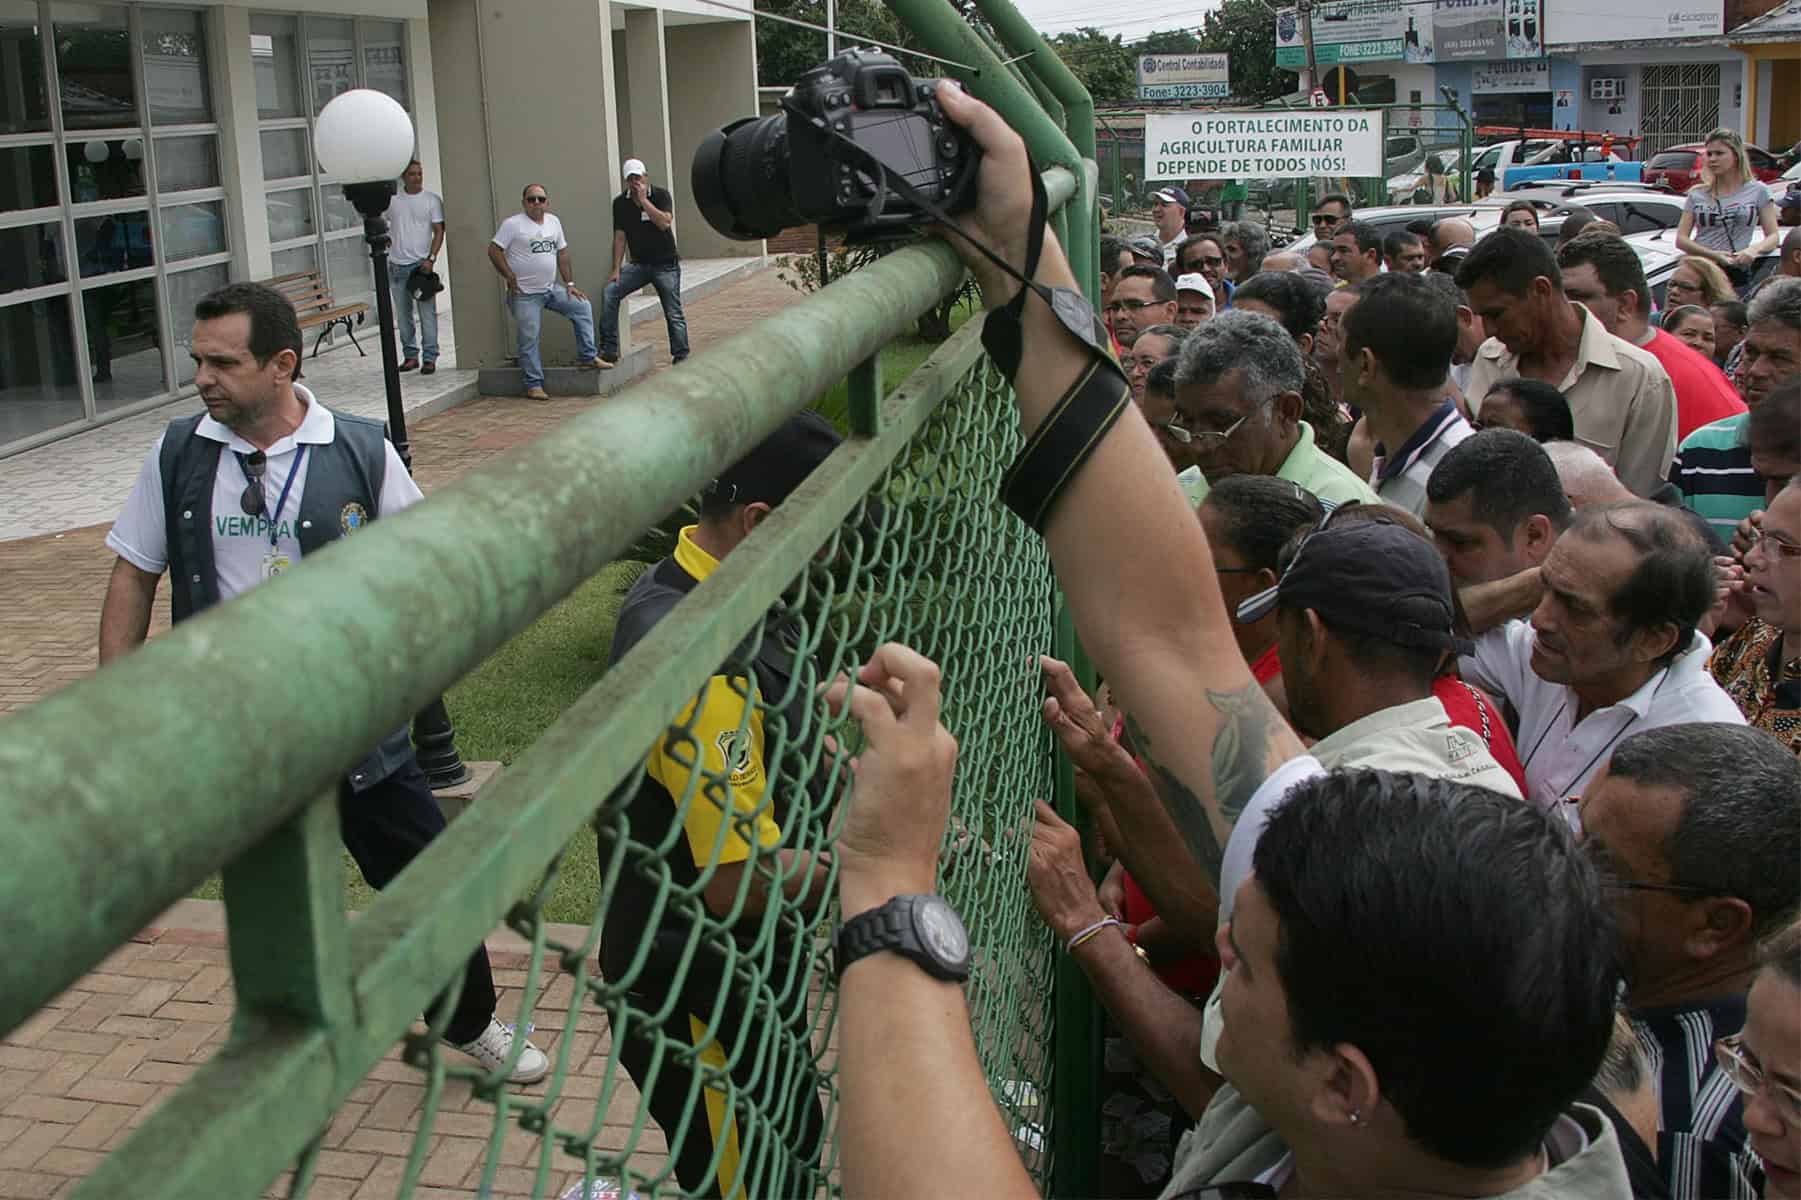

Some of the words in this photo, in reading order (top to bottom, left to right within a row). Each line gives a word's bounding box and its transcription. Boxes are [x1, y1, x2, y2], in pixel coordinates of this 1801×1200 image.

[1157, 59, 1180, 72] Central
[1182, 56, 1226, 71] Contabilidade
[1143, 86, 1172, 98] Fone:
[1191, 121, 1203, 135] O
[1206, 118, 1344, 134] FORTALECIMENTO
[1347, 118, 1369, 133] DA
[1160, 139, 1267, 156] AGRICULTURA
[1271, 138, 1343, 153] FAMILIAR
[1157, 160, 1228, 175] DEPENDE
[1231, 159, 1251, 173] DE
[1254, 158, 1307, 173] TODOS
[1310, 154, 1346, 172] NÓS!
[216, 515, 254, 538] VEM
